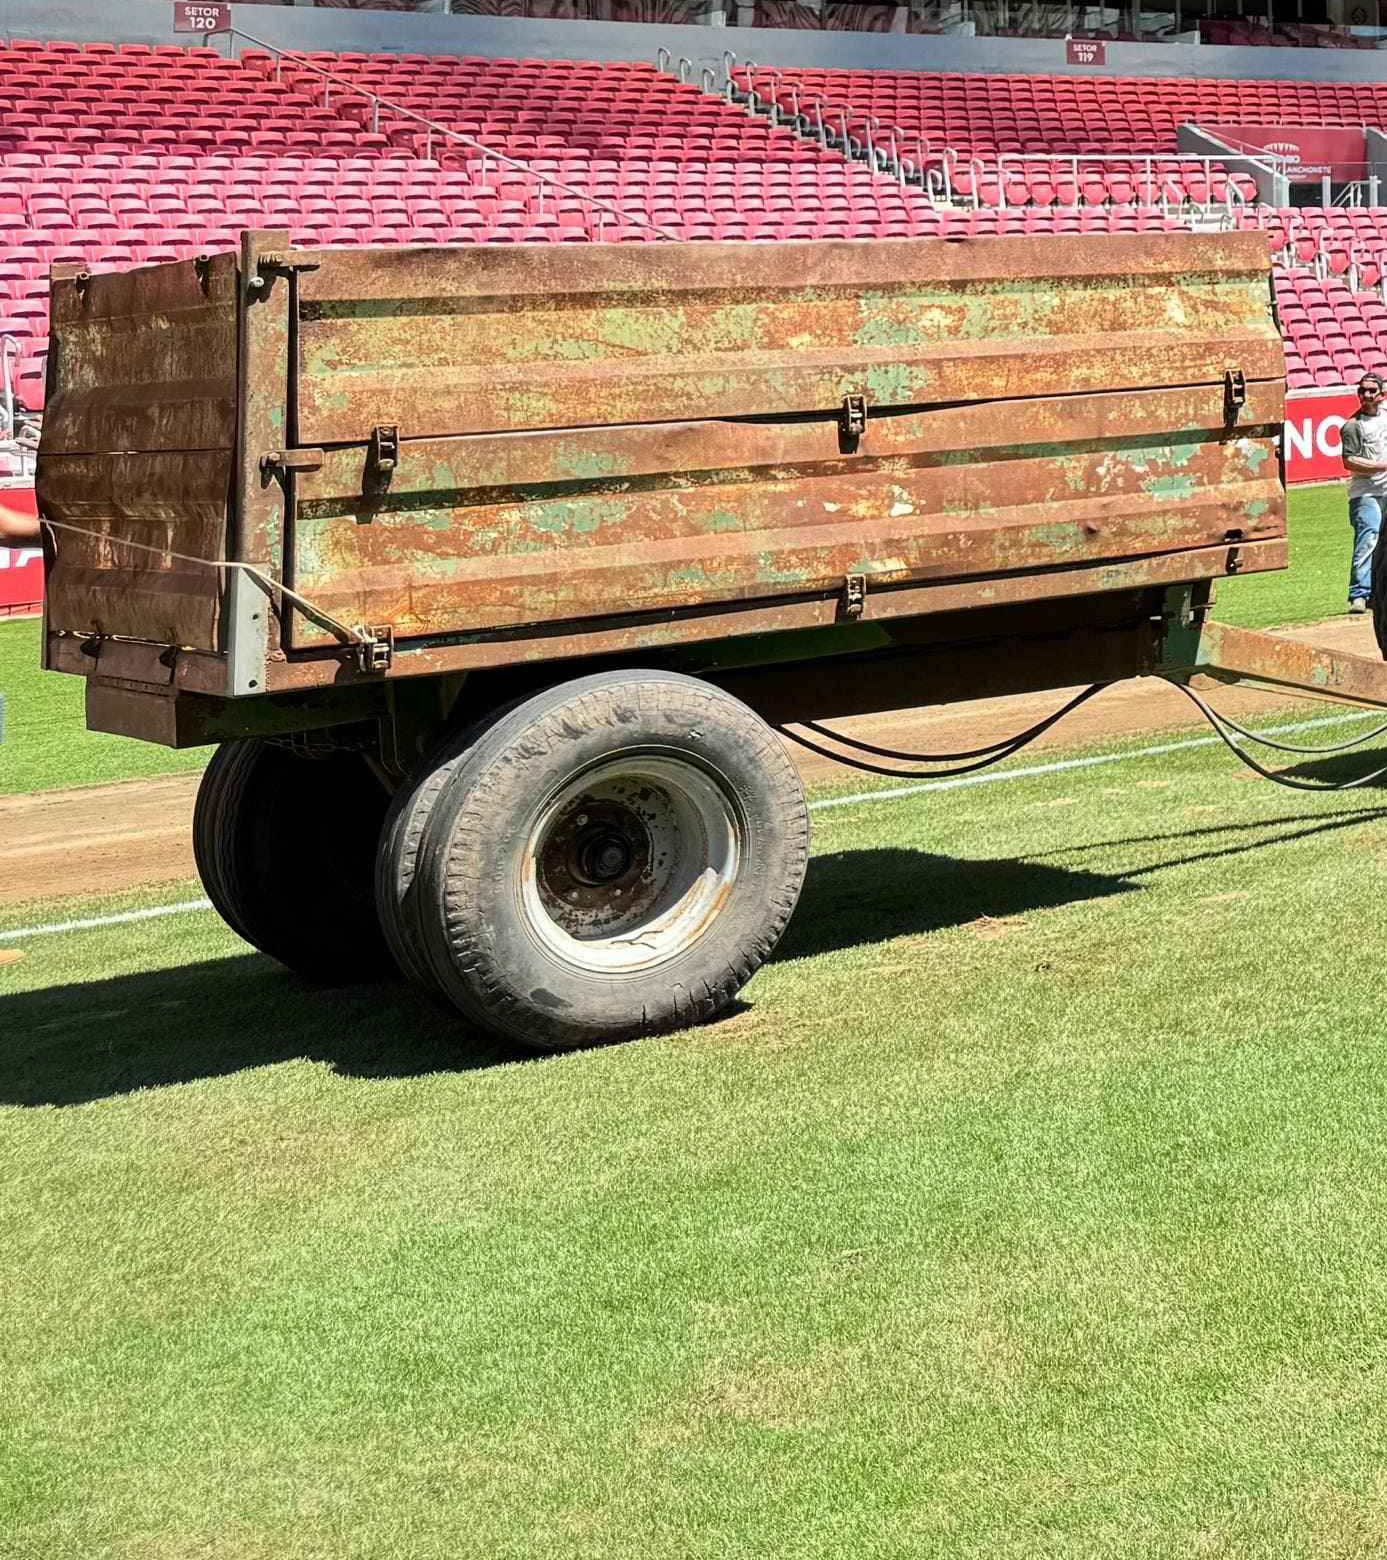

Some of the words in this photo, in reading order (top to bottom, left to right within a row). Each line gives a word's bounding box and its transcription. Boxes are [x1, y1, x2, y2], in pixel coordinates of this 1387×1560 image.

[184, 6, 219, 18] SETOR
[190, 17, 216, 29] 120
[1073, 44, 1097, 52] SETOR
[1078, 51, 1094, 63] 119
